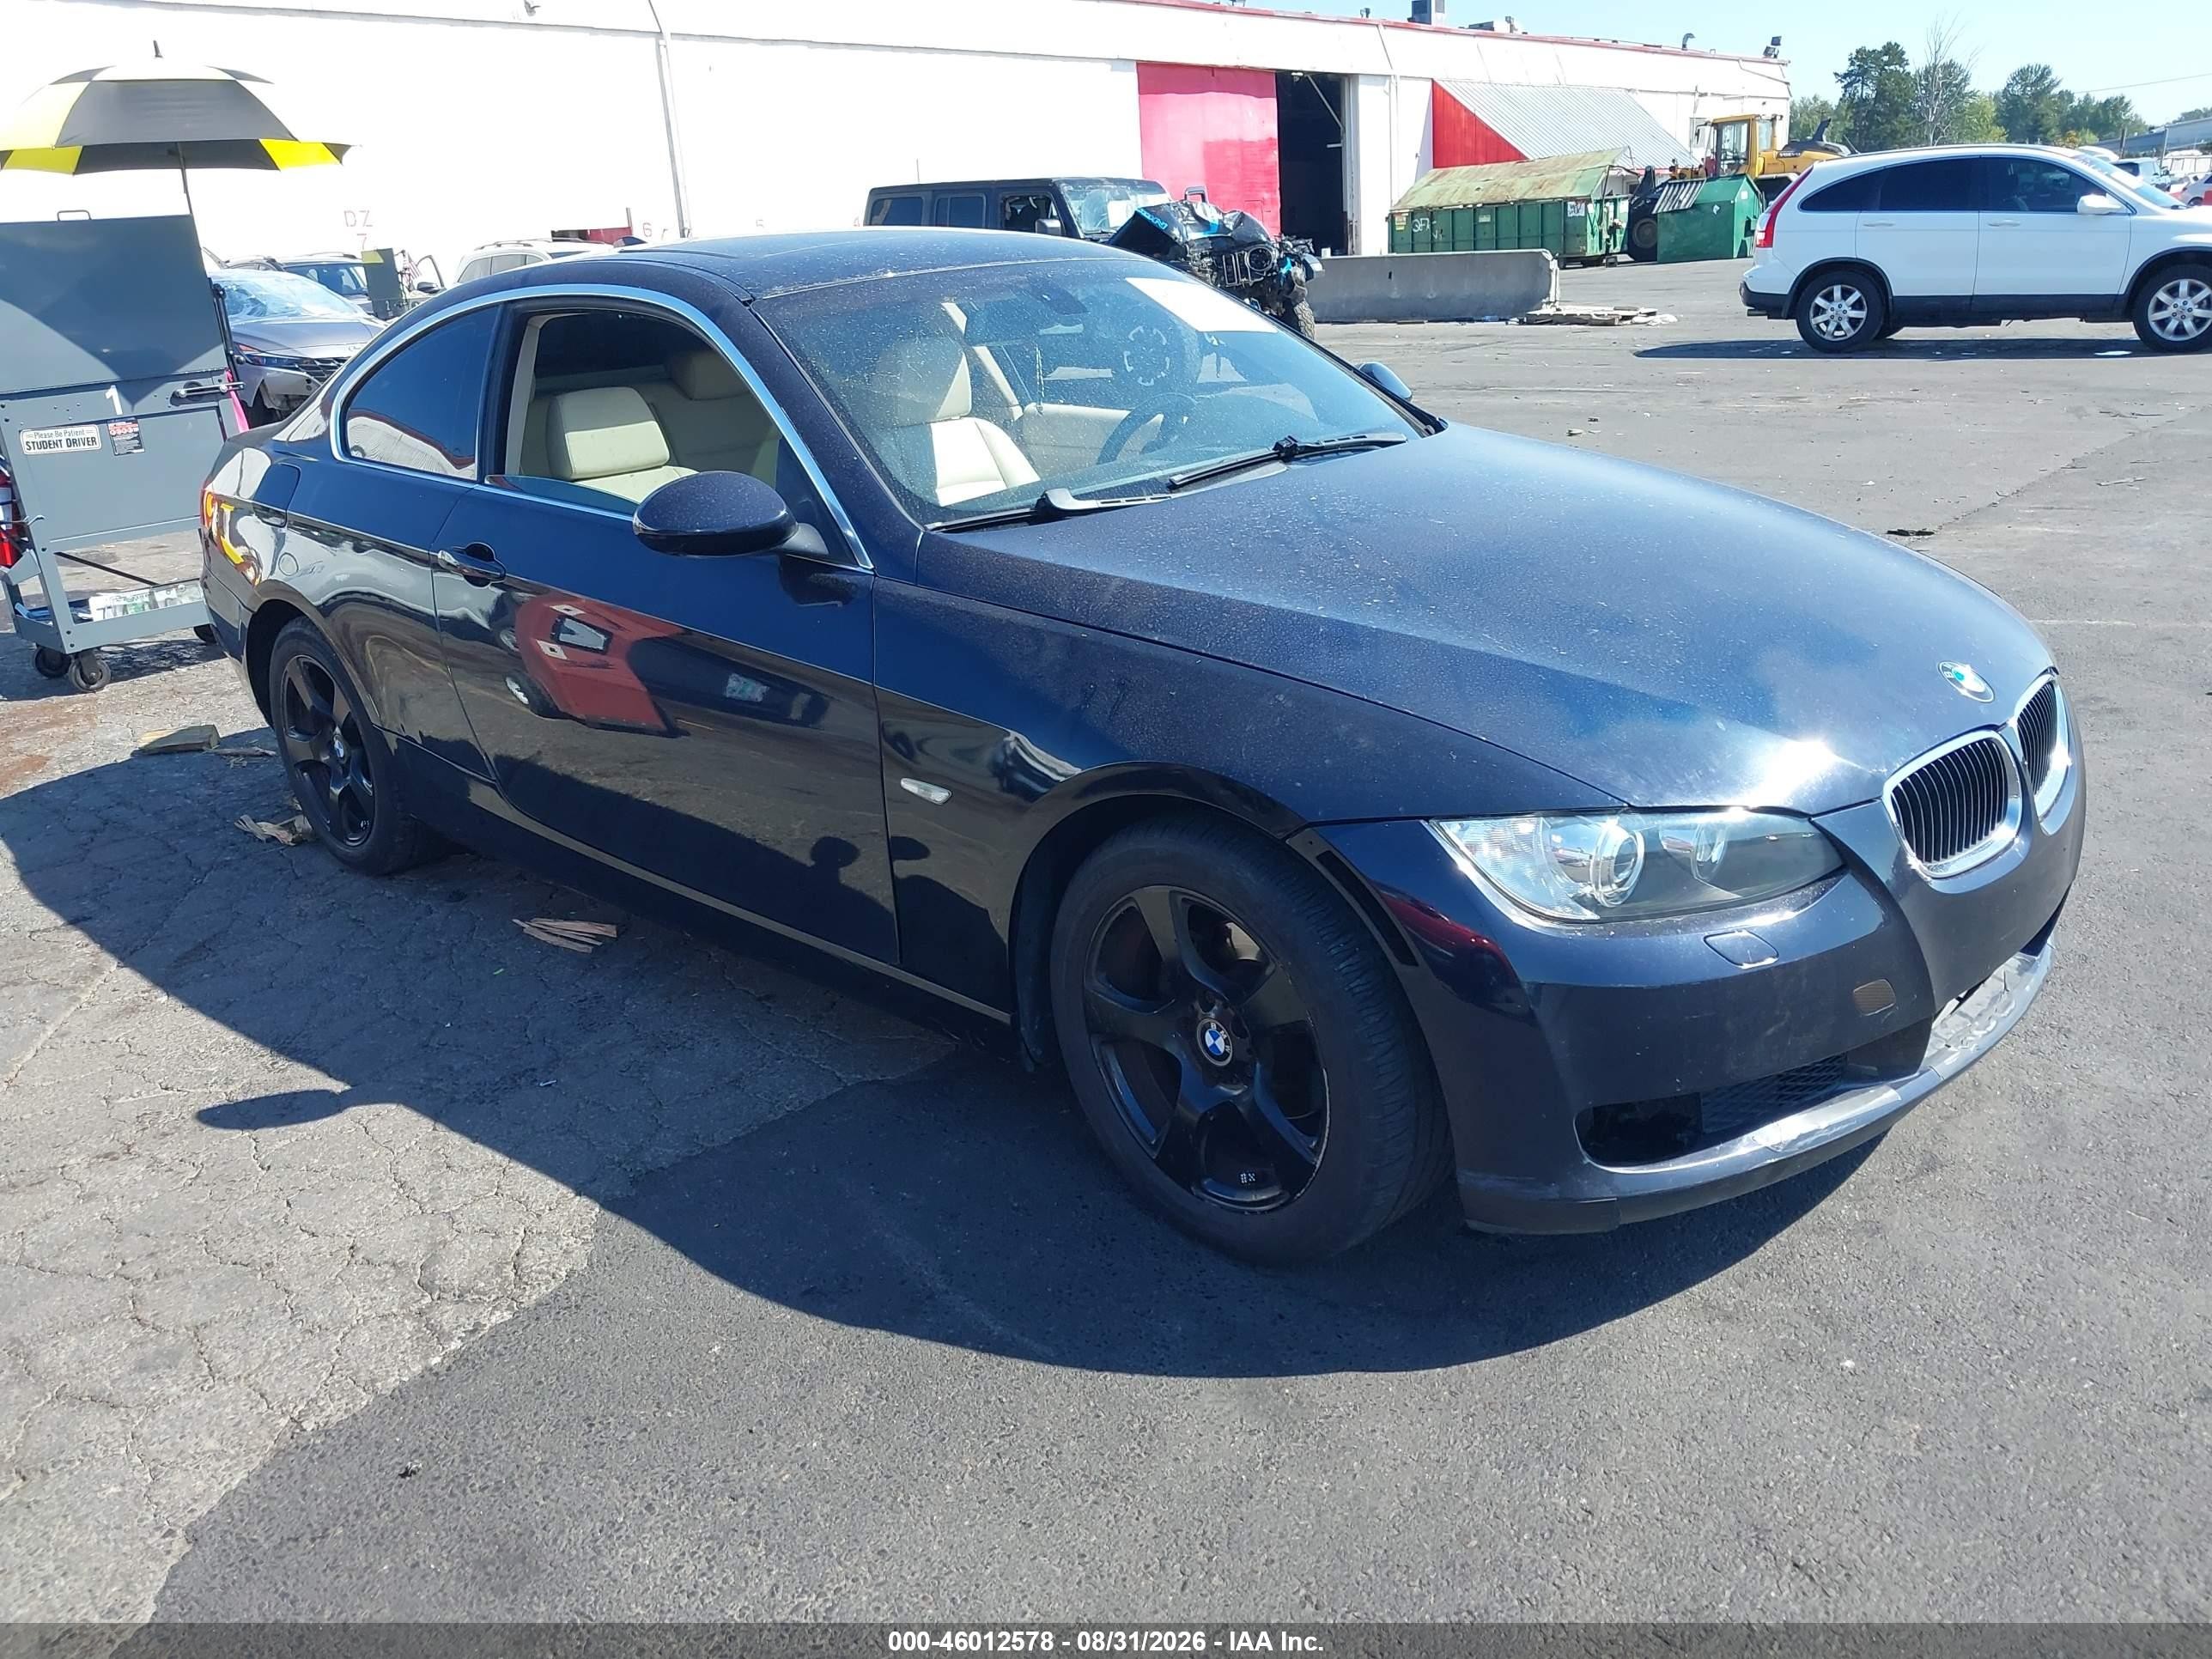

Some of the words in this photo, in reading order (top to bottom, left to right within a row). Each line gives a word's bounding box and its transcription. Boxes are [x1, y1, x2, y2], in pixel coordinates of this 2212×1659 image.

[642, 222, 653, 237] 6
[106, 385, 123, 415] 1
[26, 439, 63, 451] STUDENT
[66, 436, 97, 447] DRIVER
